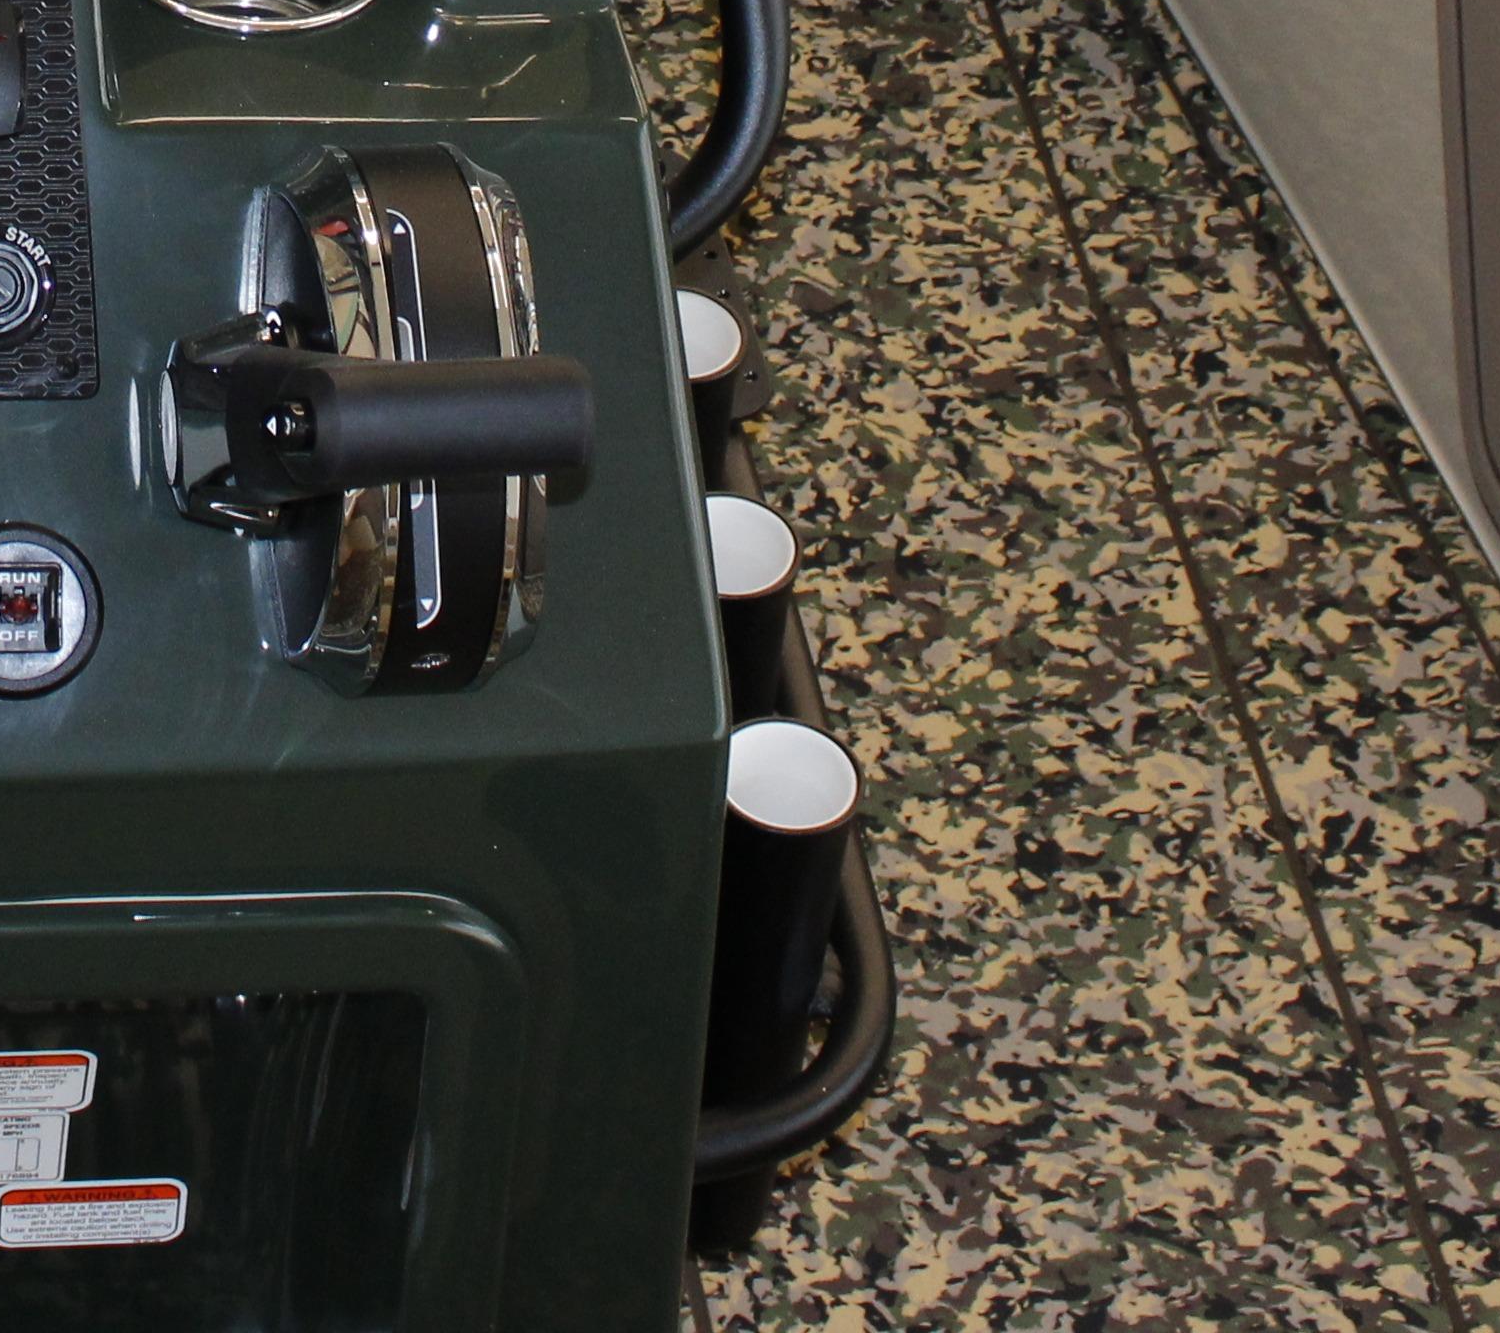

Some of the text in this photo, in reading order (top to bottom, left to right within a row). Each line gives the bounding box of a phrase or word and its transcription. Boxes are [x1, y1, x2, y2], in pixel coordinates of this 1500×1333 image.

[5, 226, 51, 267] START
[0, 572, 41, 583] RUN
[0, 630, 39, 642] OFF
[44, 1191, 136, 1201] WARNING
